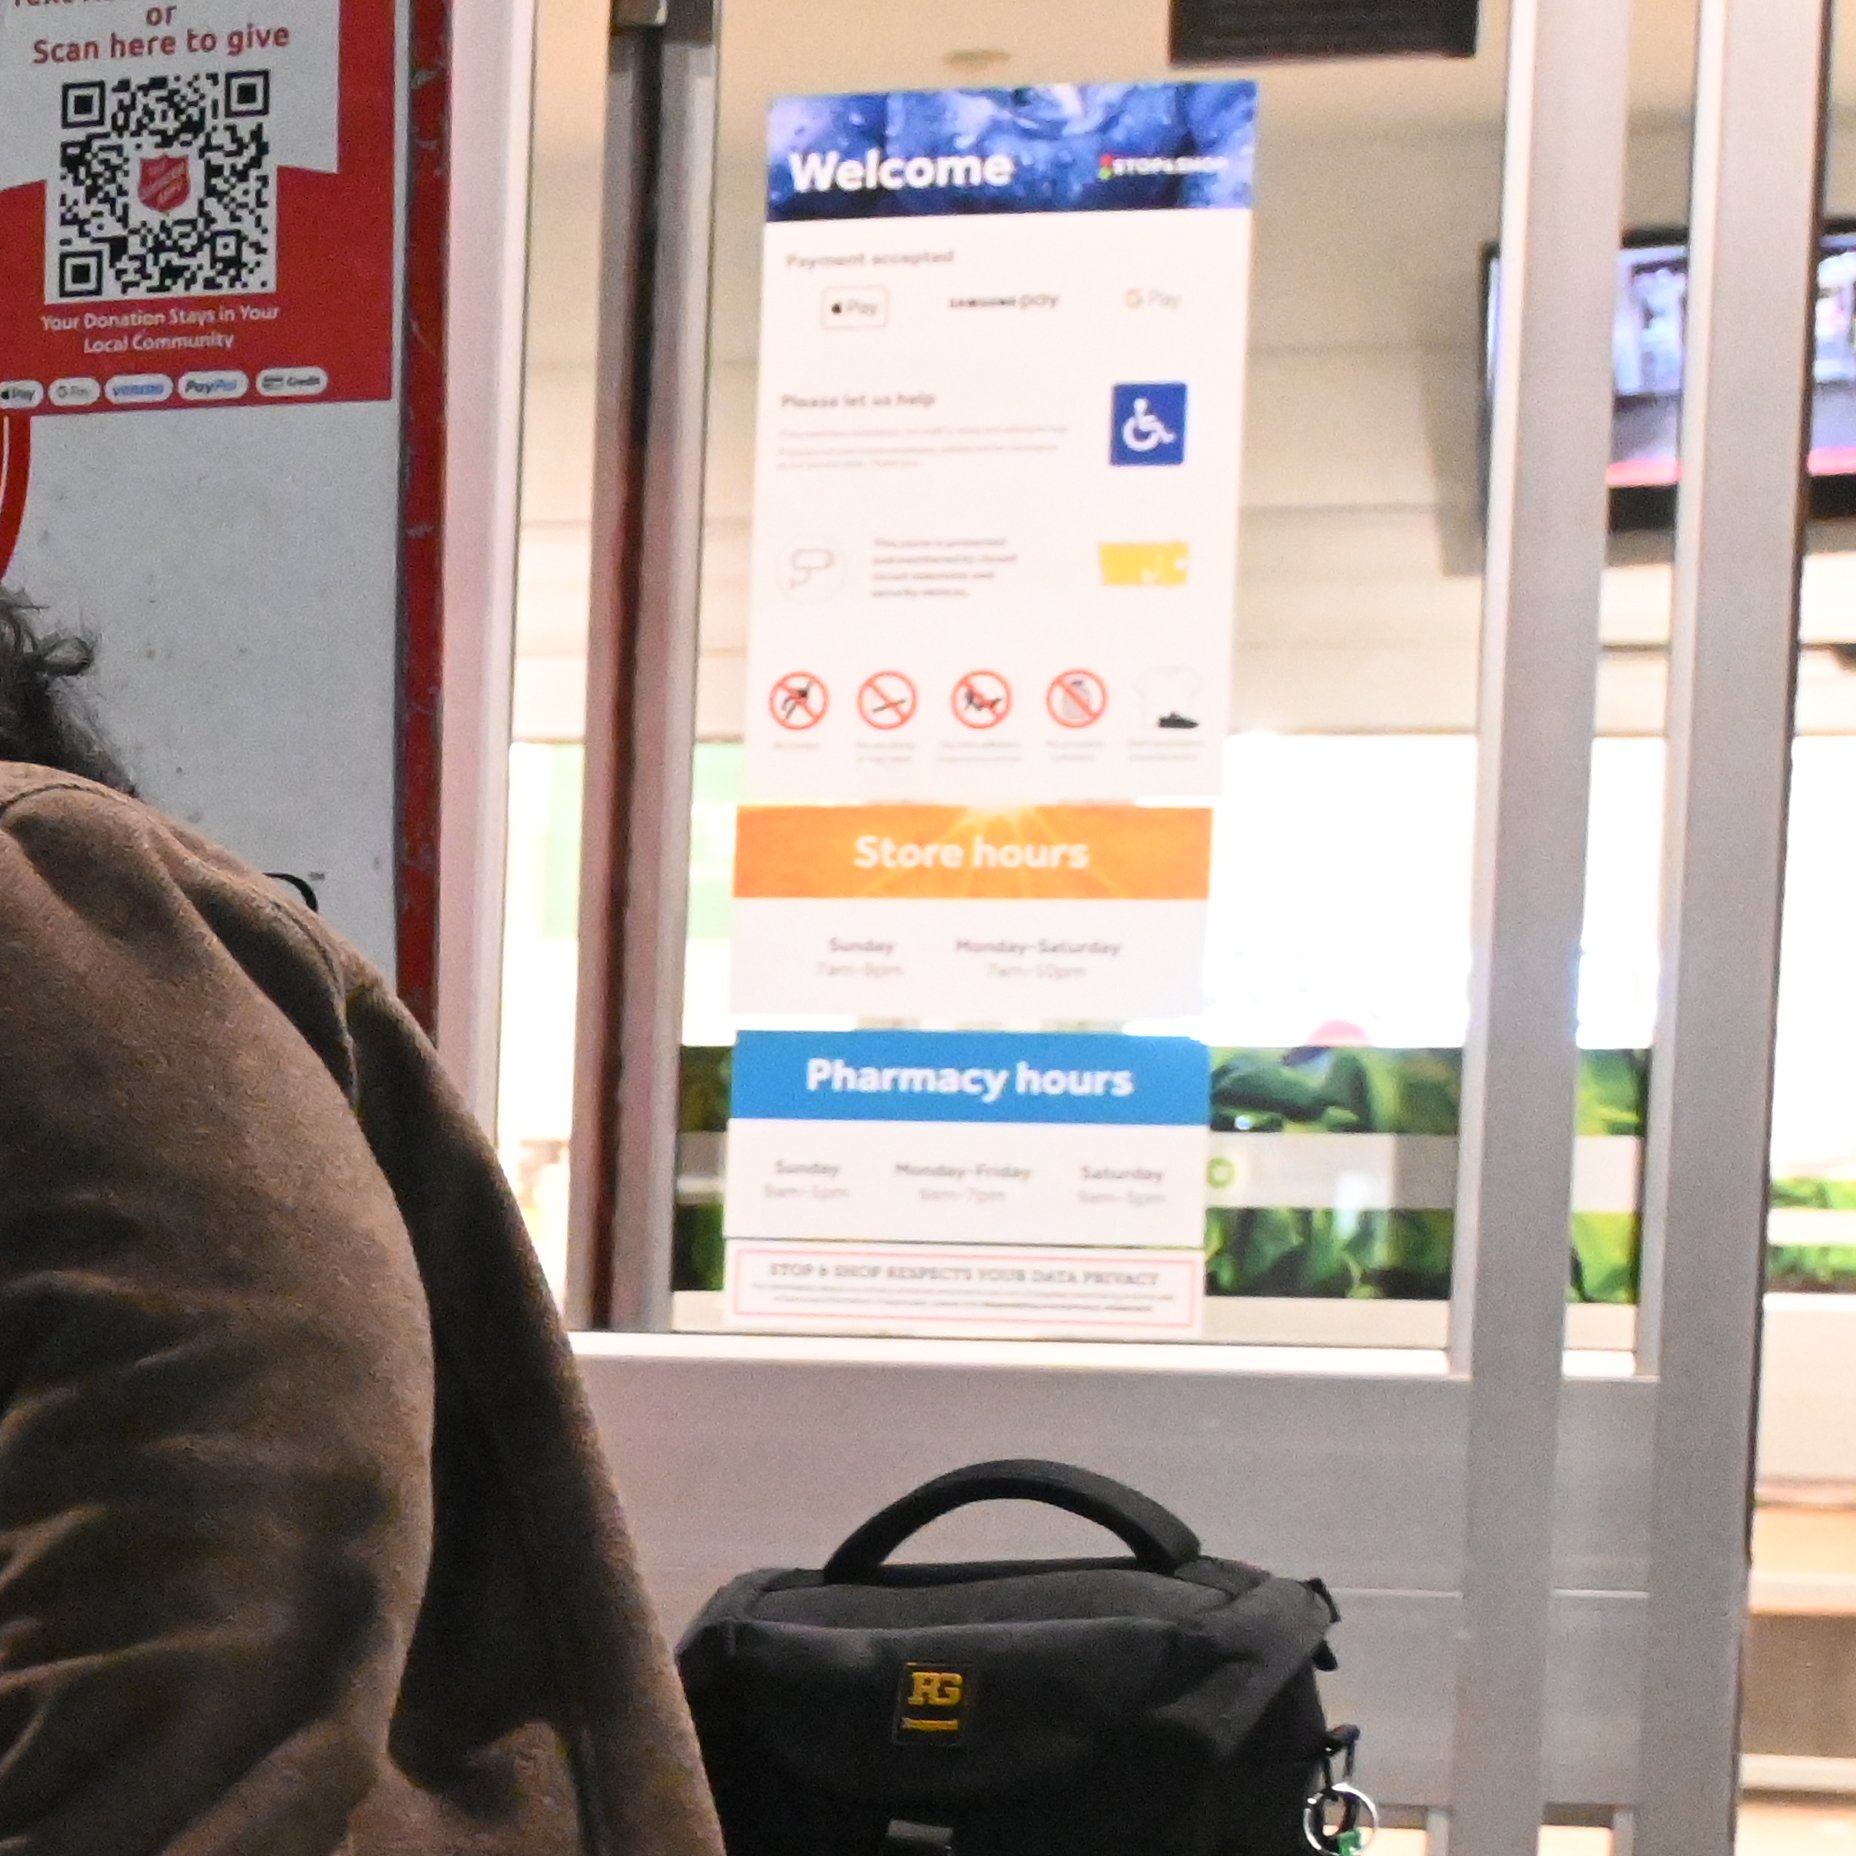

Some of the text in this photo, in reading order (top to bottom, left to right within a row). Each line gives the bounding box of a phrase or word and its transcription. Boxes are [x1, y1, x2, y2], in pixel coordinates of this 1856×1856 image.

[146, 5, 177, 26] or
[33, 24, 289, 64] Scan here to give
[791, 147, 1014, 193] Welcome
[786, 252, 864, 270] Payment
[41, 304, 280, 332] Your Donation Stays in Your
[83, 330, 235, 355] Local Community
[854, 835, 1089, 870] Store hours
[829, 936, 895, 956] Sunday
[805, 1058, 1135, 1102] Pharmacy hours
